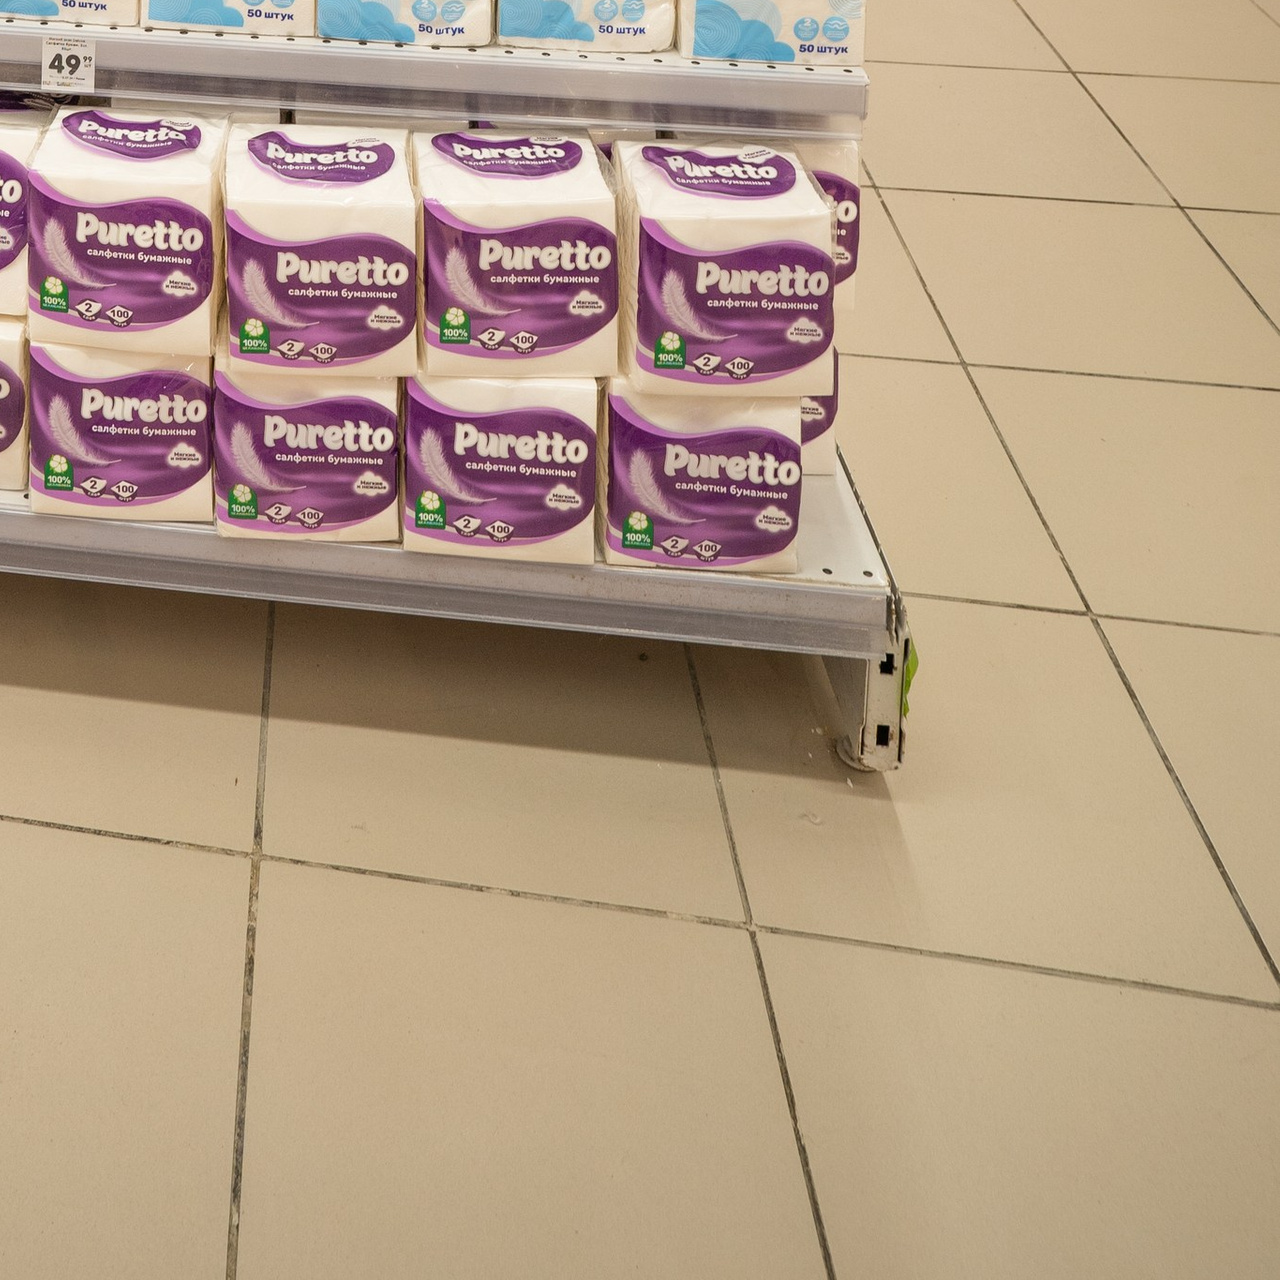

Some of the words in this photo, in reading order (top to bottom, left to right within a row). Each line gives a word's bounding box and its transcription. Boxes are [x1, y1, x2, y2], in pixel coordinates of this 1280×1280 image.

[62, 0, 75, 7] 50
[78, 0, 107, 11] штук
[48, 53, 80, 74] 49
[77, 213, 204, 252] Puretto
